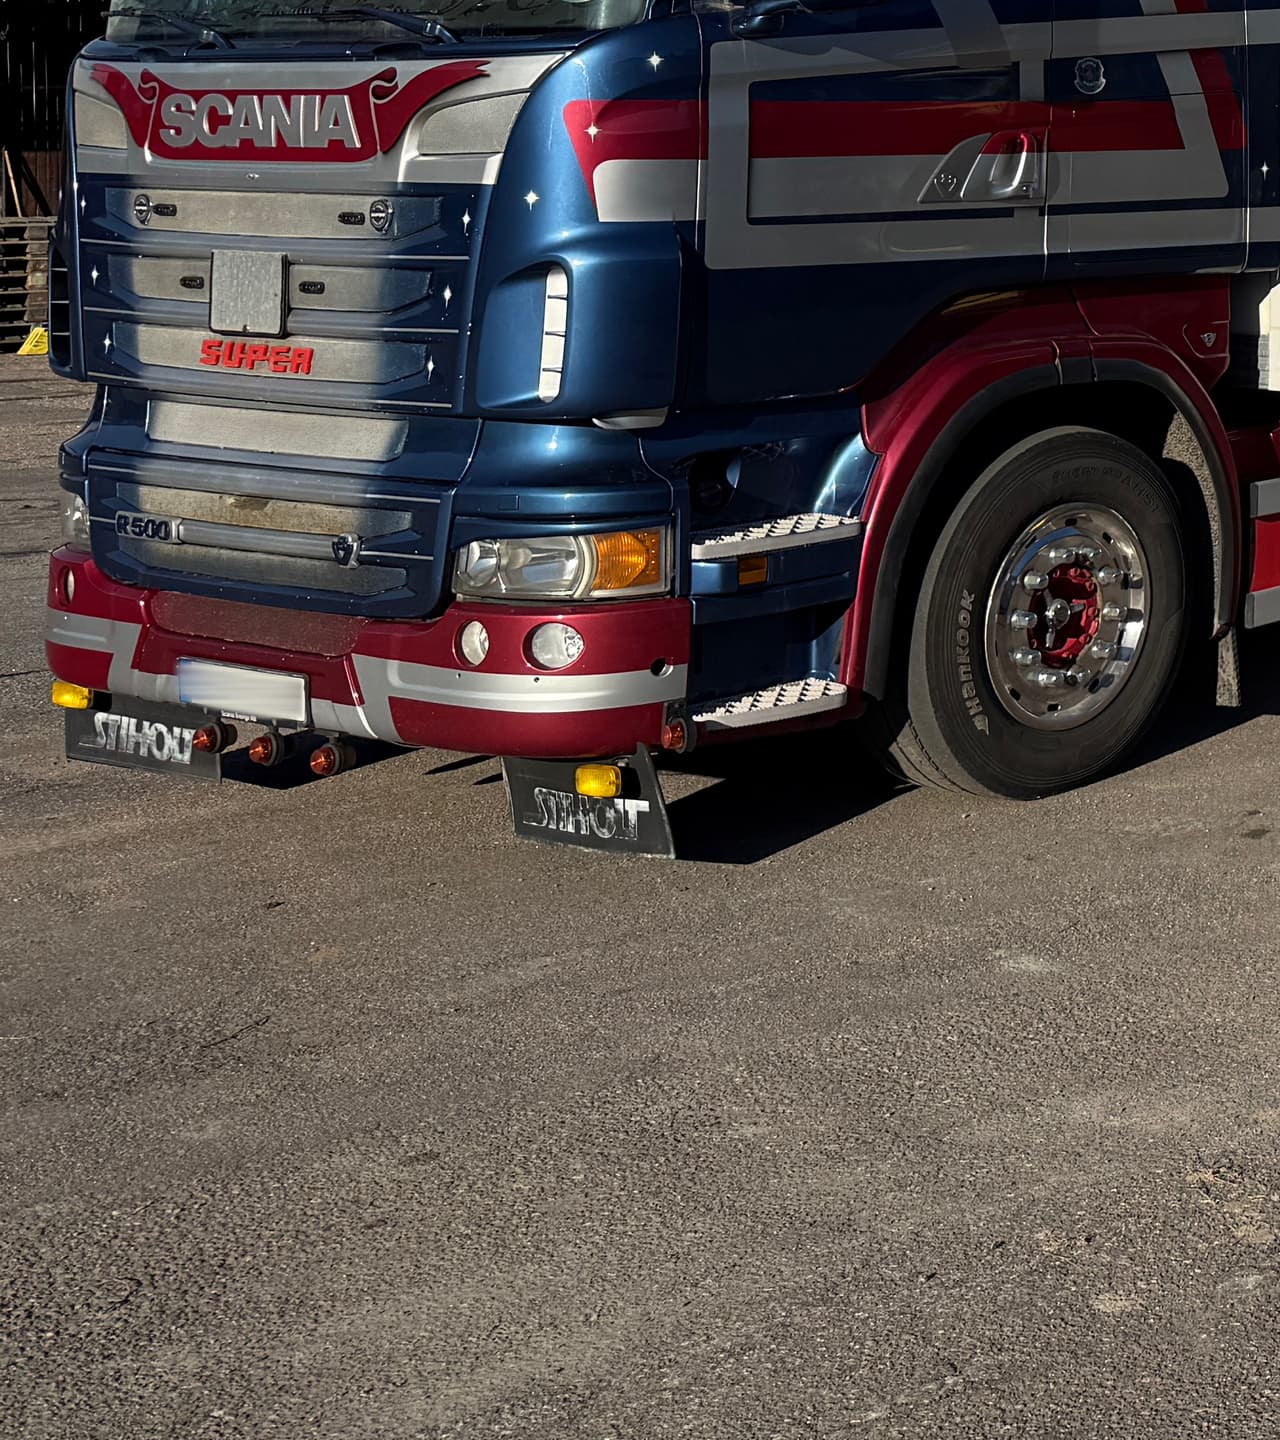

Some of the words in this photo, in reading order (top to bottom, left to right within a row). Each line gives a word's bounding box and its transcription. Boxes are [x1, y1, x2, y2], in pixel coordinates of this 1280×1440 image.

[159, 93, 362, 148] SCANIA
[199, 339, 314, 375] SUPER
[116, 514, 129, 535] R
[131, 516, 171, 541] 500
